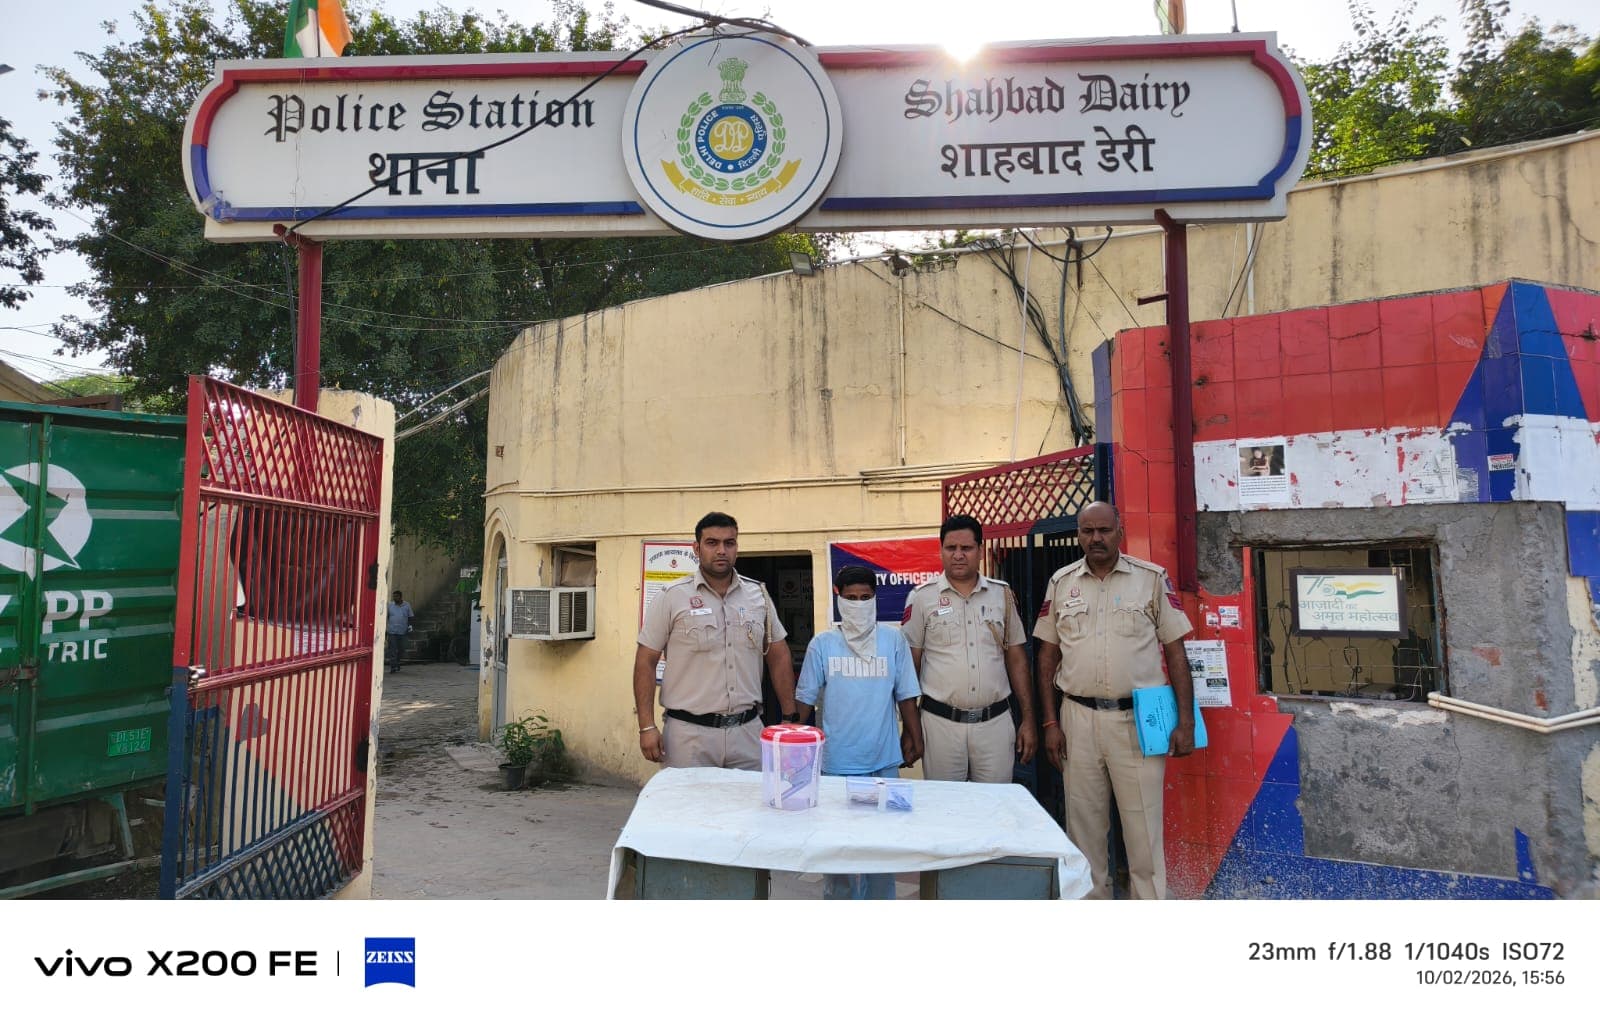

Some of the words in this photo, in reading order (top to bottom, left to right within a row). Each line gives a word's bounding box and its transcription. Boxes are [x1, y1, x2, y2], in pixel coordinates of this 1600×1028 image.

[265, 93, 407, 143] Police
[422, 89, 597, 132] Station
[904, 76, 1066, 124] Shahbad
[1077, 72, 1191, 118] Dairy
[697, 110, 719, 143] POLICE
[369, 150, 486, 195] थाना
[699, 145, 722, 170] DELHI
[940, 140, 1086, 183] शाहबाद
[1094, 124, 1157, 174] डेरी
[875, 573, 888, 586] TY
[828, 656, 888, 677] PUMA
